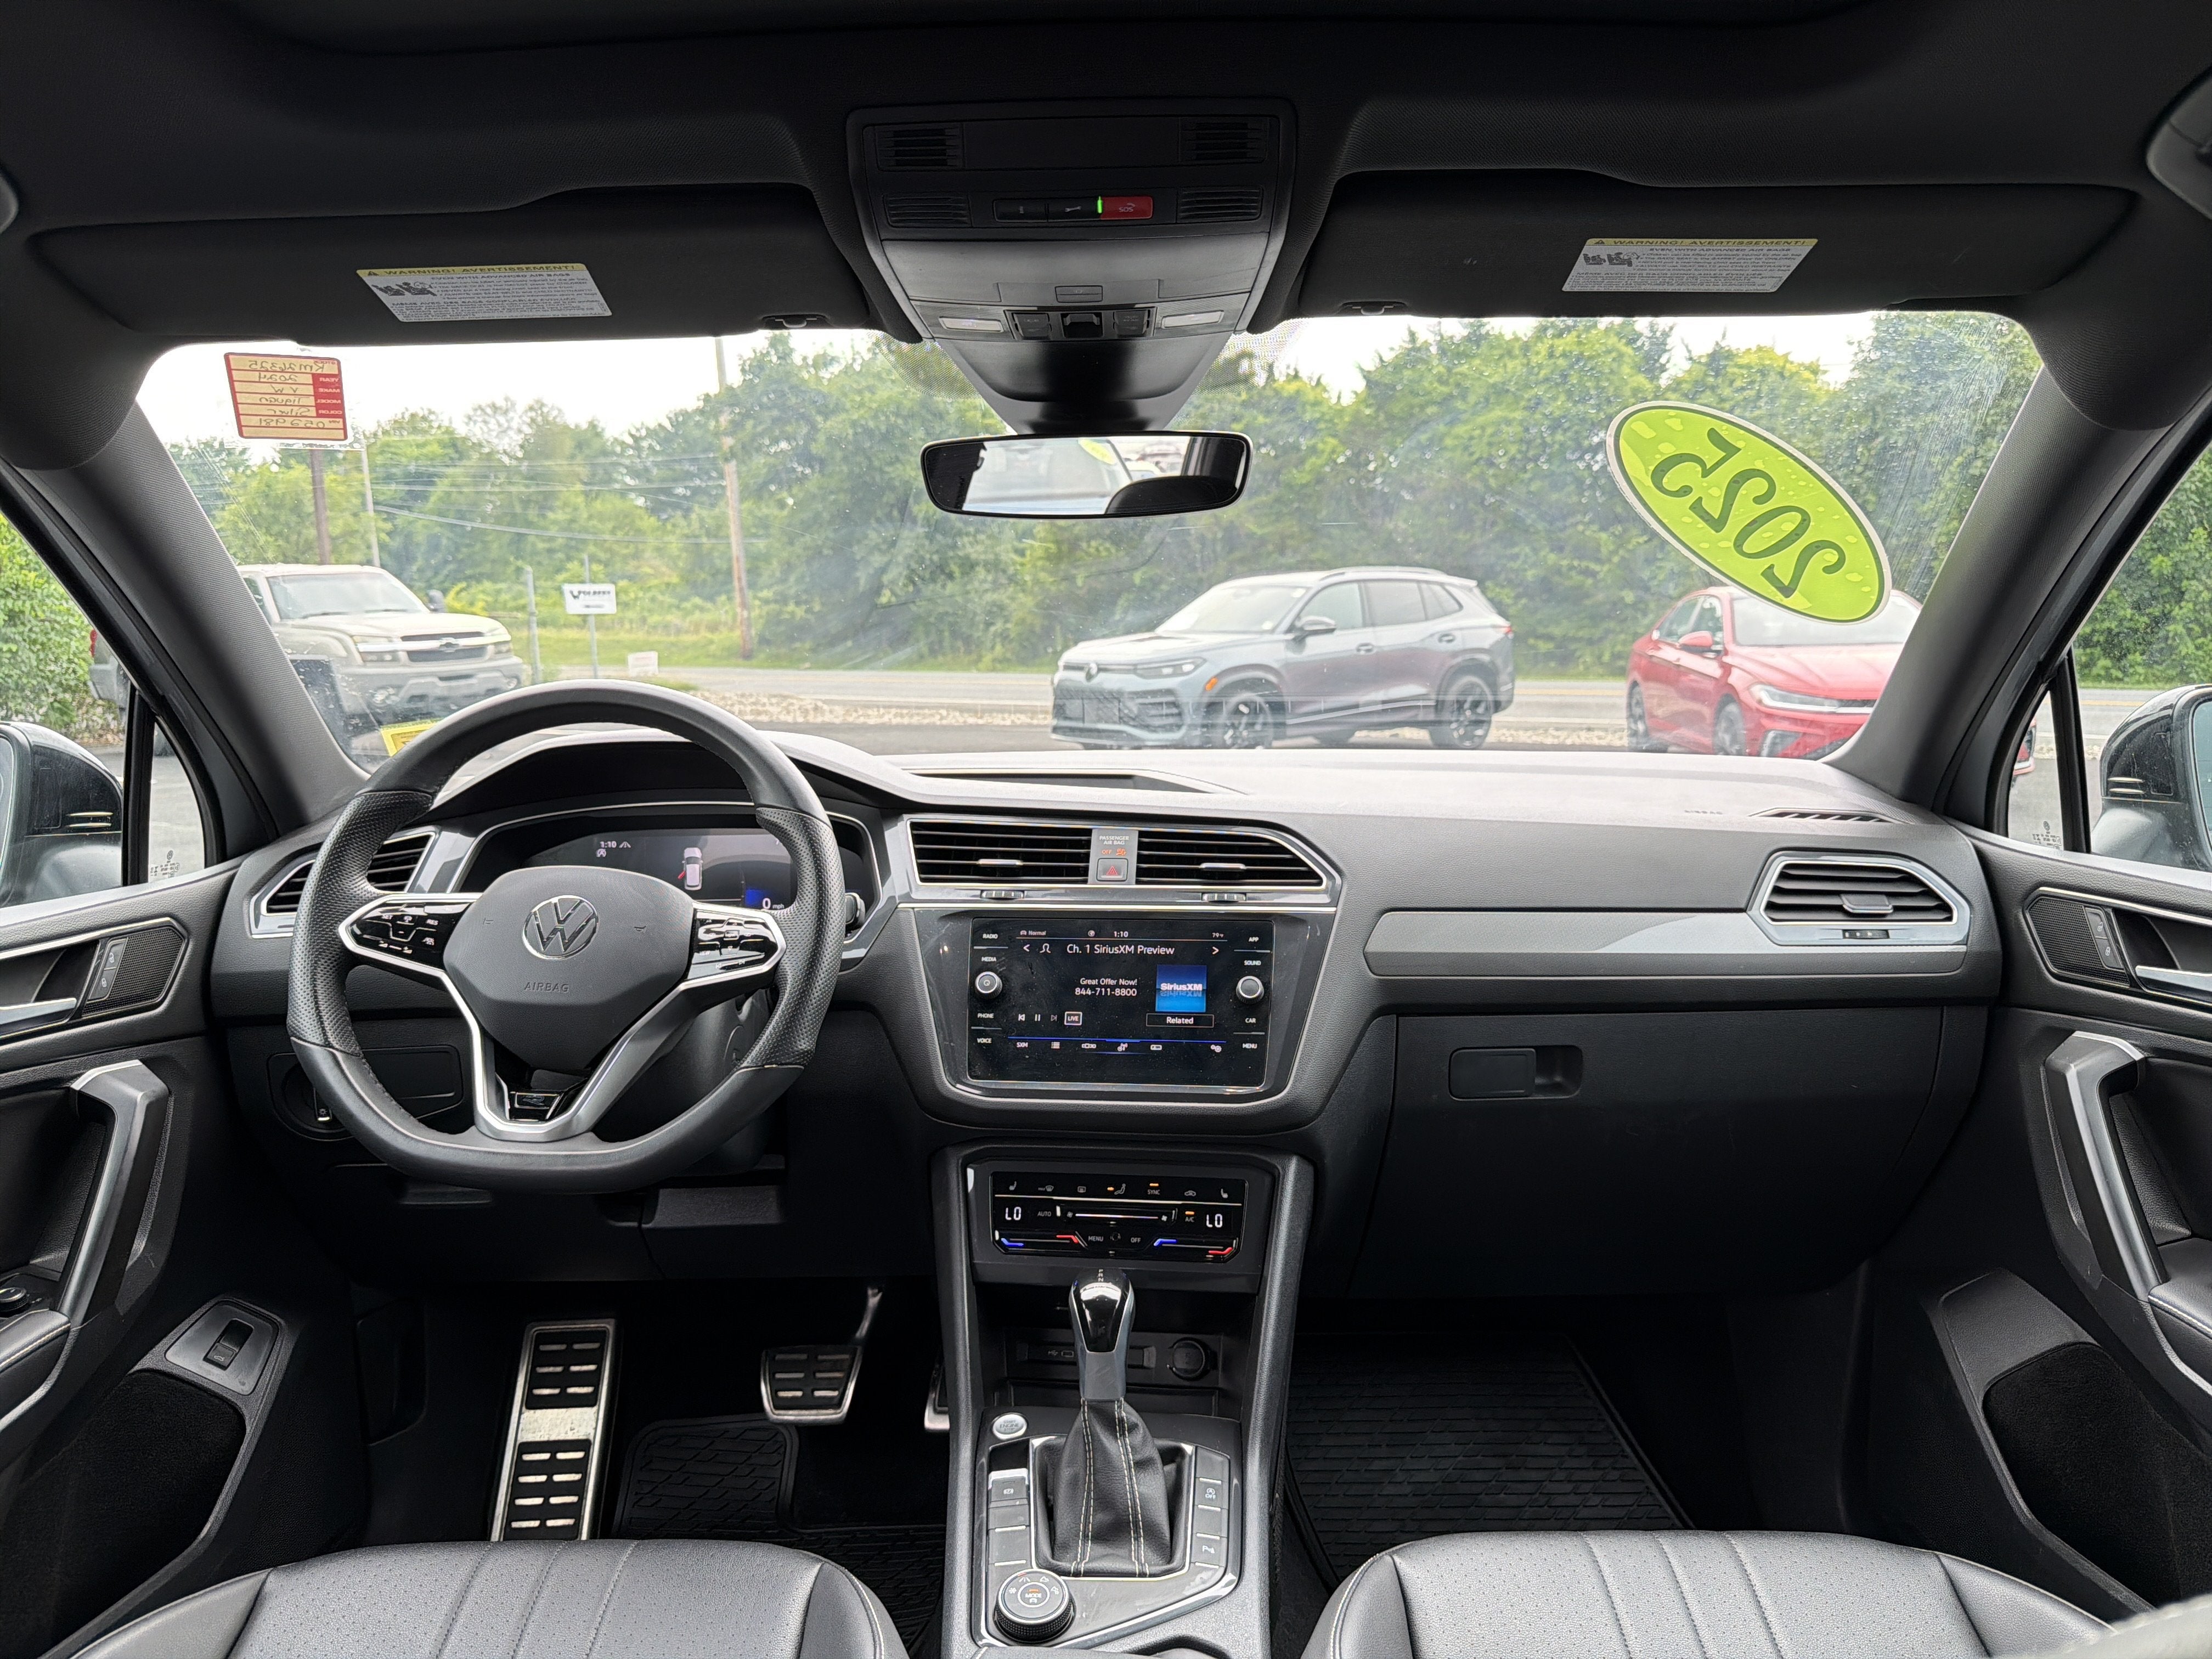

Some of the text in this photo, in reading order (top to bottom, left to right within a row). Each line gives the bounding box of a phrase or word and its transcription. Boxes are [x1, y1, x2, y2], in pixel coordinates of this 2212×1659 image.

[762, 898, 771, 910] 0
[1066, 944, 1175, 955] Ch. 1 SiriusXM Preview
[524, 981, 569, 992] AIRBAG
[1075, 988, 1137, 996] 844-711-8800
[1160, 983, 1203, 991] SiriusXM
[1005, 1206, 1022, 1221] LO
[1206, 1214, 1223, 1228] LO
